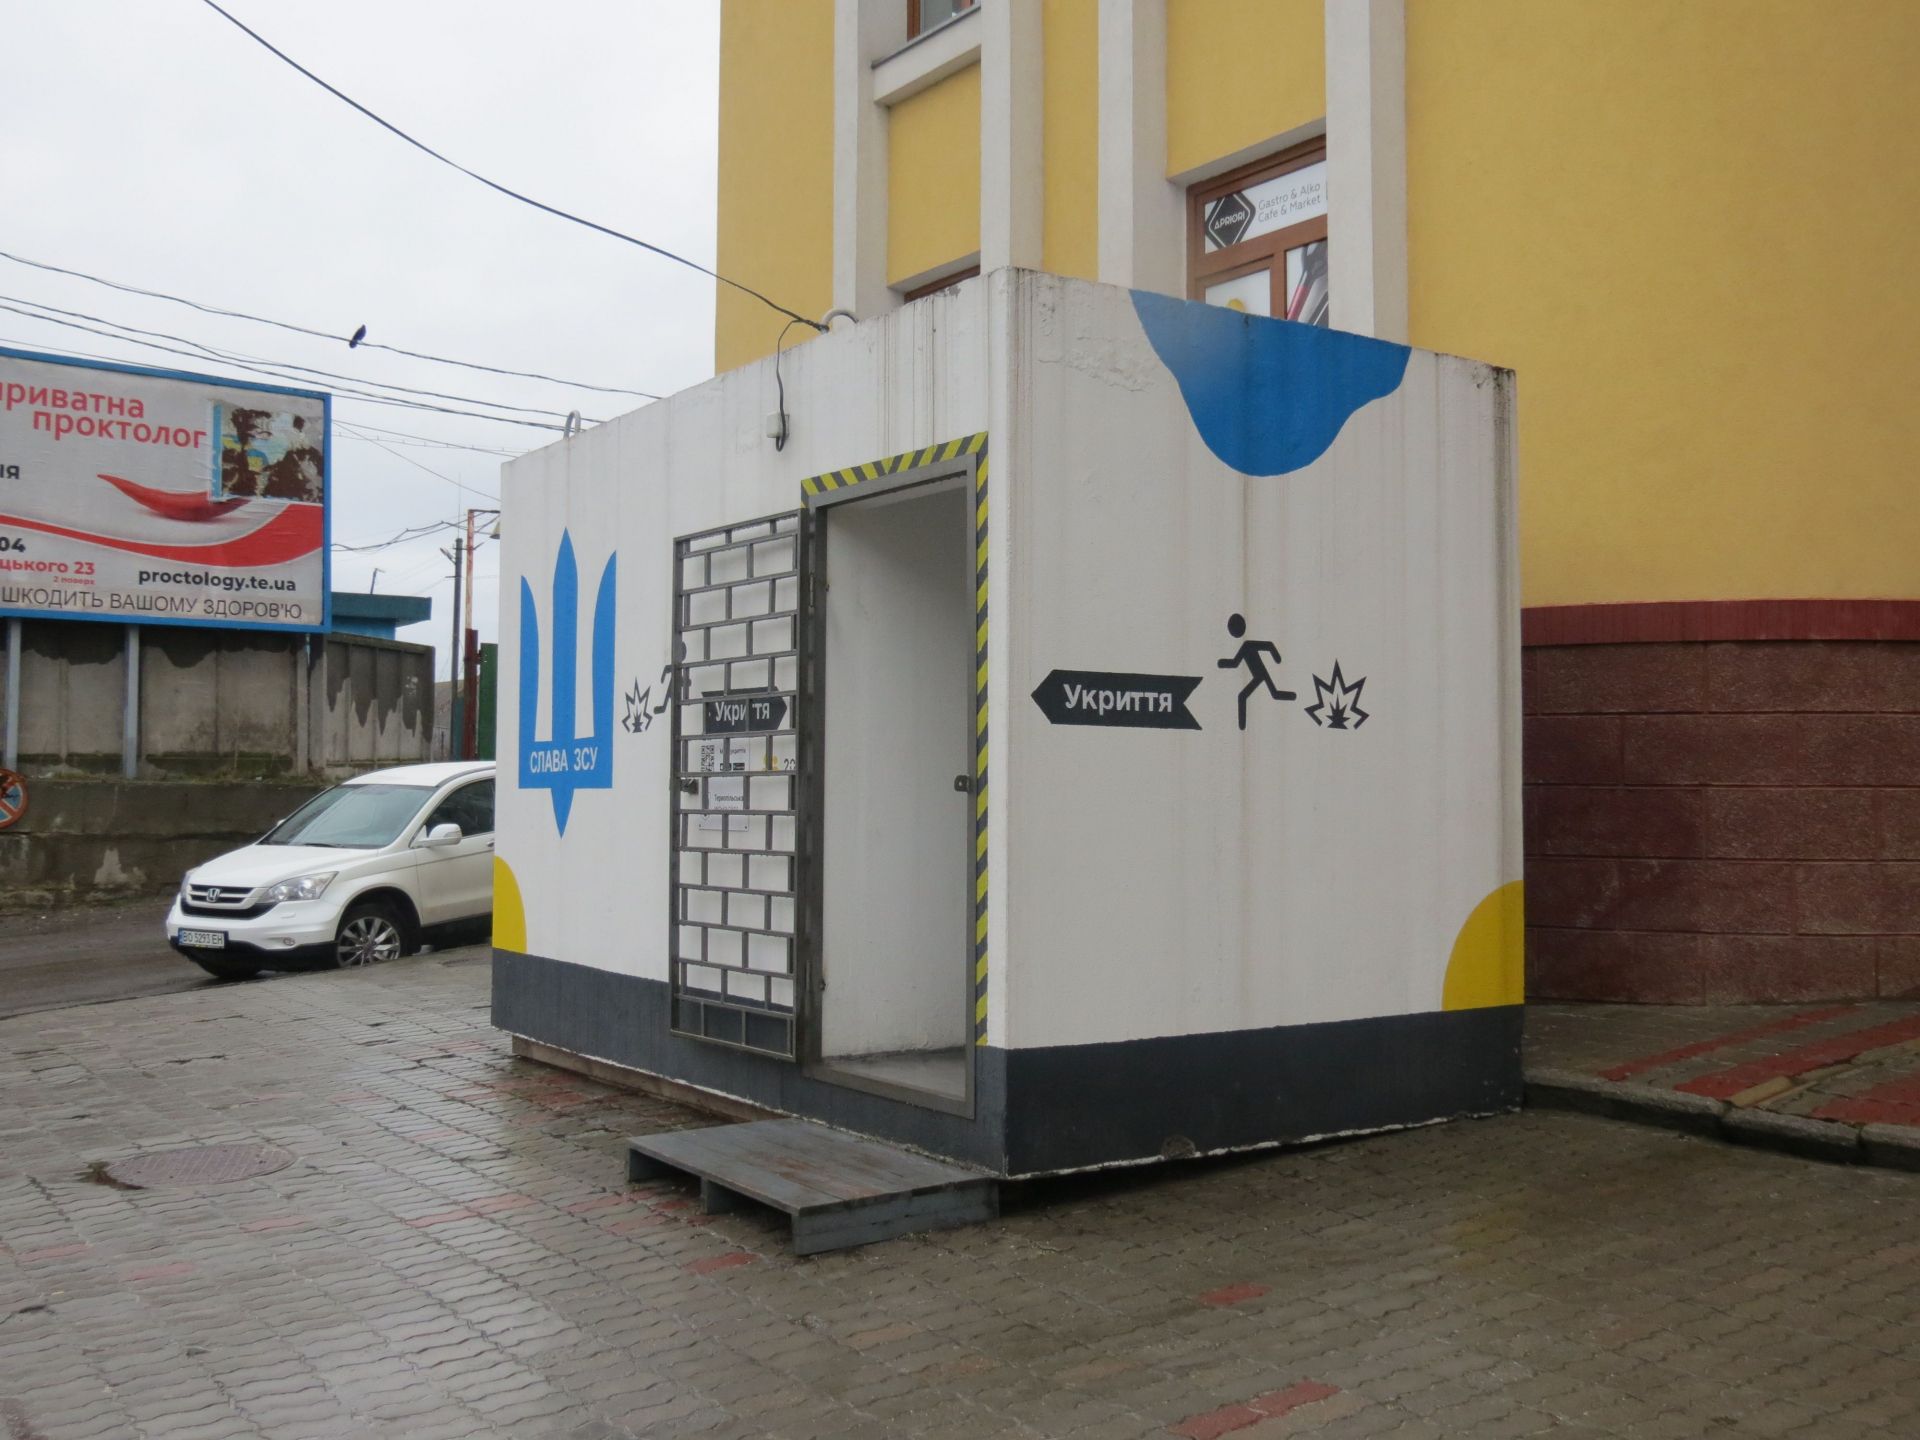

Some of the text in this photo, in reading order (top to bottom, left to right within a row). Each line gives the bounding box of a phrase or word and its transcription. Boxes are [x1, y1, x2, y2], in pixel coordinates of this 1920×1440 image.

[1258, 183, 1321, 211] Gastro & Alko
[1258, 194, 1321, 223] Cafe & Market
[1213, 210, 1246, 231] APRIORI
[32, 410, 207, 449] проктолог
[73, 561, 96, 576] 23
[138, 570, 297, 592] proctology.te.ua
[1, 585, 302, 619] ШКОДИТЬ ВАШОМУ ЗДОРОВ'Ю
[1063, 683, 1173, 716] Укриття
[715, 701, 770, 726] Укритя
[529, 746, 599, 773] СЛАВА ЗСУ
